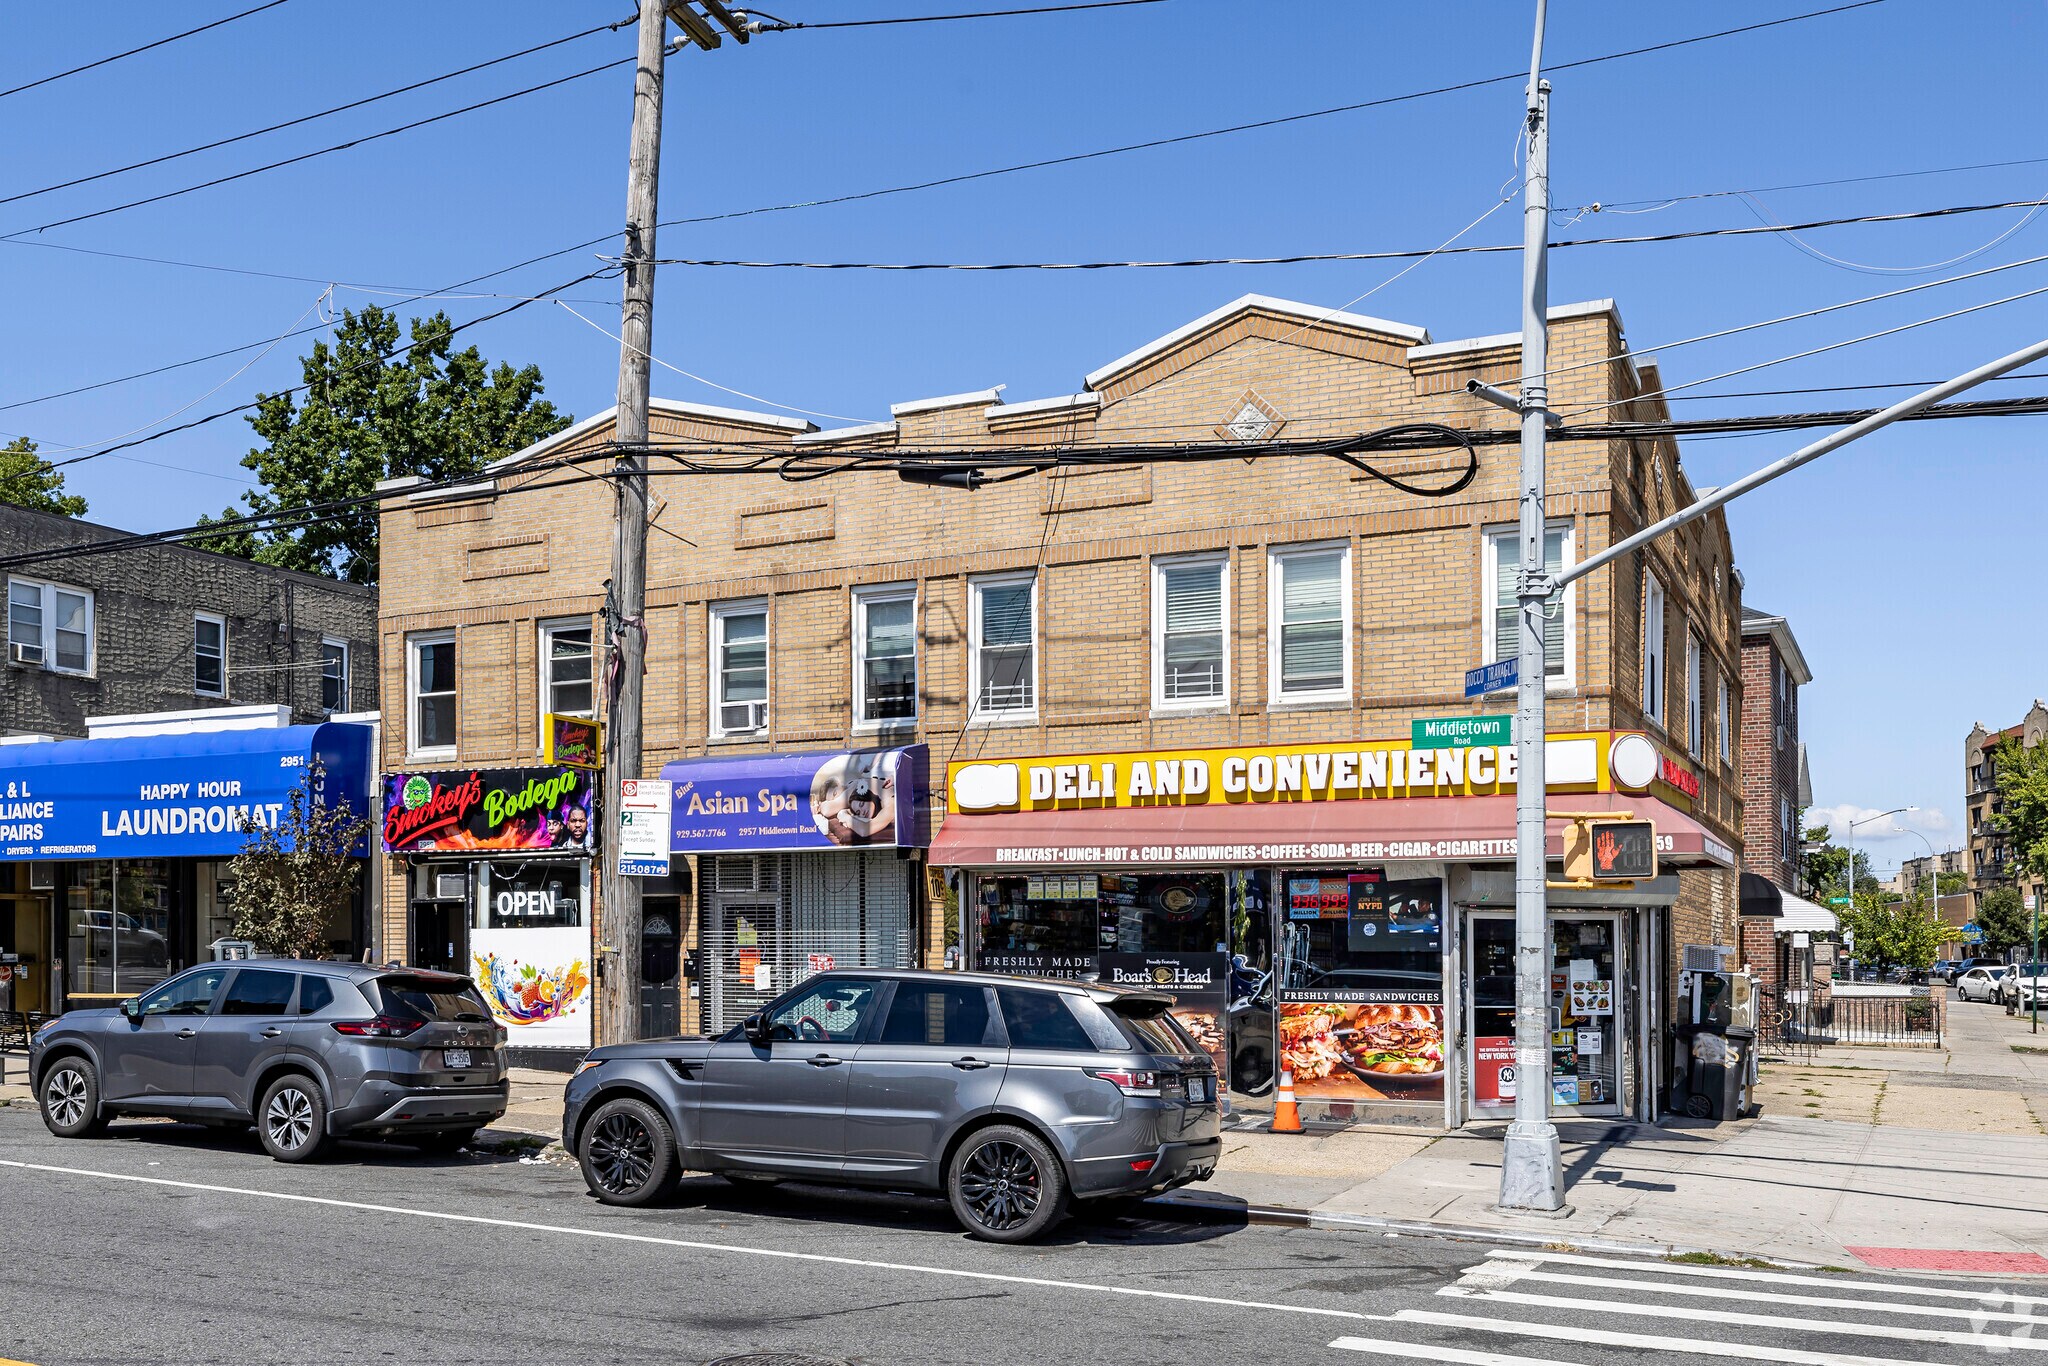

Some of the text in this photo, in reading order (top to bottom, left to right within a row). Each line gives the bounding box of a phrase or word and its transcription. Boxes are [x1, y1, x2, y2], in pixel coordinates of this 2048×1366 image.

[1466, 669, 1484, 688] ROCCO
[1483, 680, 1502, 691] CORNER
[1424, 719, 1500, 738] Middletown
[1453, 737, 1471, 745] Road
[280, 755, 304, 767] 2951
[1029, 746, 1518, 800] DELI AND CONVENIENCE
[7, 781, 31, 798] & L
[140, 780, 241, 801] HAPPY HOUR
[674, 780, 694, 800] Blue
[385, 769, 577, 844] Smokey's Bodega
[687, 788, 798, 816] Asian Spa
[0, 801, 54, 820] LIANCE
[102, 803, 283, 837] LAUNDROMAT
[623, 812, 631, 825] 2
[0, 823, 44, 841] PAIRS
[676, 828, 727, 839] 929.567.7766
[738, 827, 757, 837] 2957
[799, 824, 817, 834] Road
[7, 844, 97, 855] DRYERS REFRIGERATORS
[1130, 848, 1140, 861] &
[1141, 846, 1172, 861] COLD
[497, 890, 556, 916] OPEN
[1292, 894, 1348, 909] 336 999
[1357, 902, 1383, 910] NYPD
[984, 956, 1091, 967] FRESHLY MADE
[1112, 967, 1211, 983] Boar's Head
[1284, 991, 1439, 1002] FRESHLY MADE SANDWICHES
[1478, 1052, 1493, 1061] NEW
[1492, 1052, 1509, 1061] YORK
